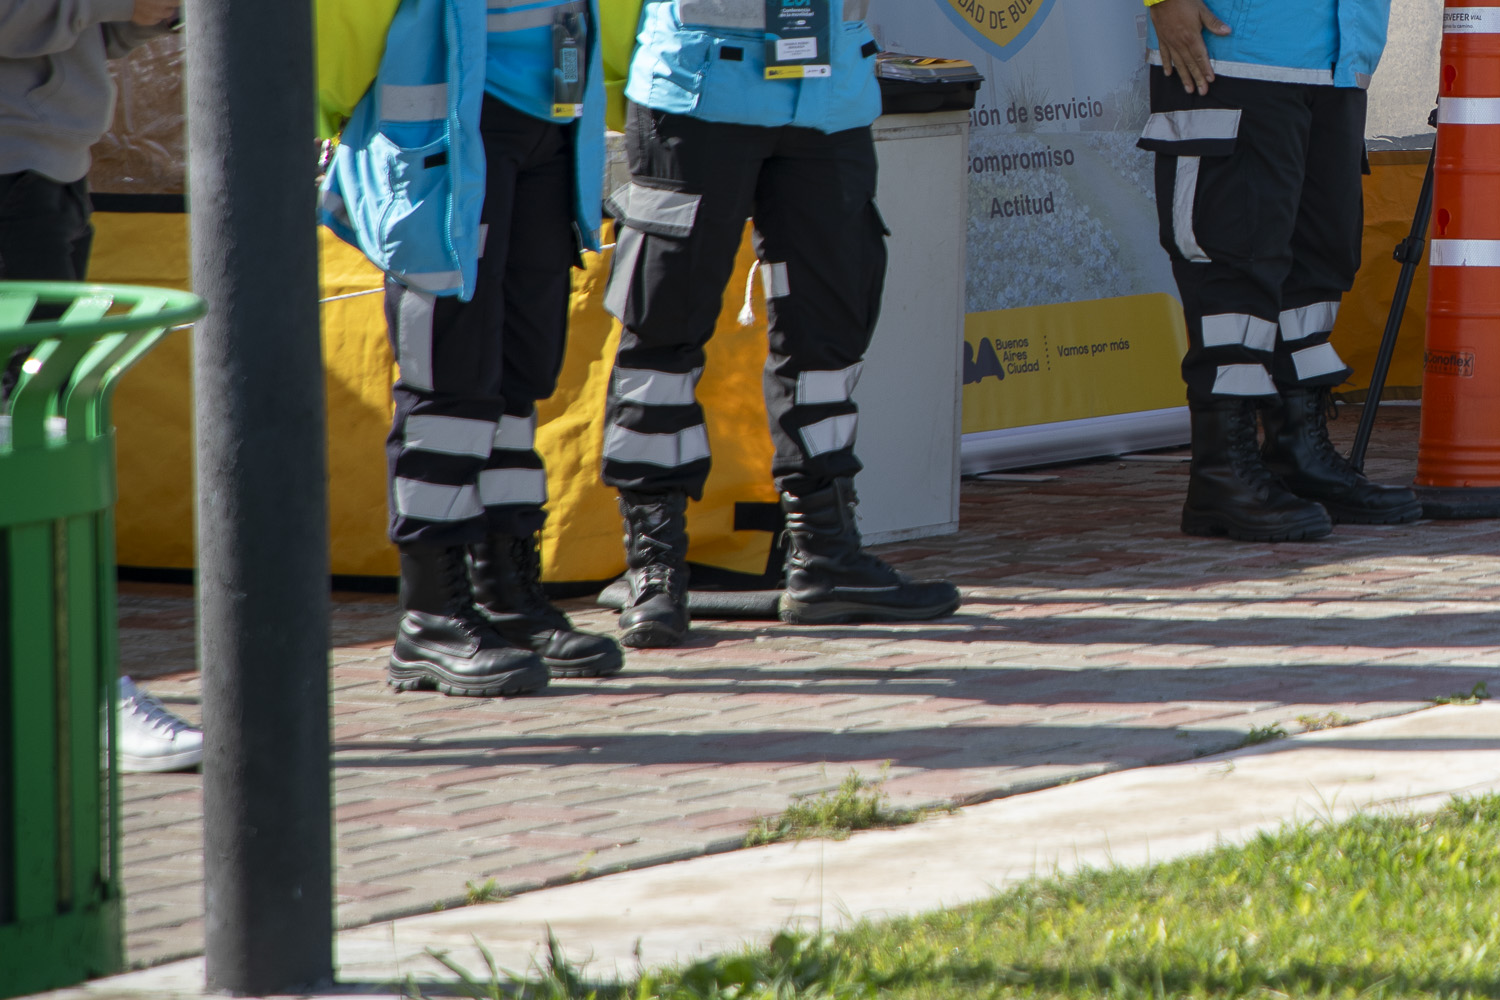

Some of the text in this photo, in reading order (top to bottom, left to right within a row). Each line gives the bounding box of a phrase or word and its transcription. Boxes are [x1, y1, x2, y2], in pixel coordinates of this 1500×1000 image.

[989, 9, 1008, 30] DE
[968, 96, 1103, 127] ión de servicio
[967, 146, 1075, 175] ompromiso
[990, 191, 1056, 219] Actitud
[995, 337, 1029, 351] Buenos
[1057, 337, 1130, 357] Vamos por más
[1003, 350, 1028, 363] Aires
[1006, 360, 1040, 375] Ciudad
